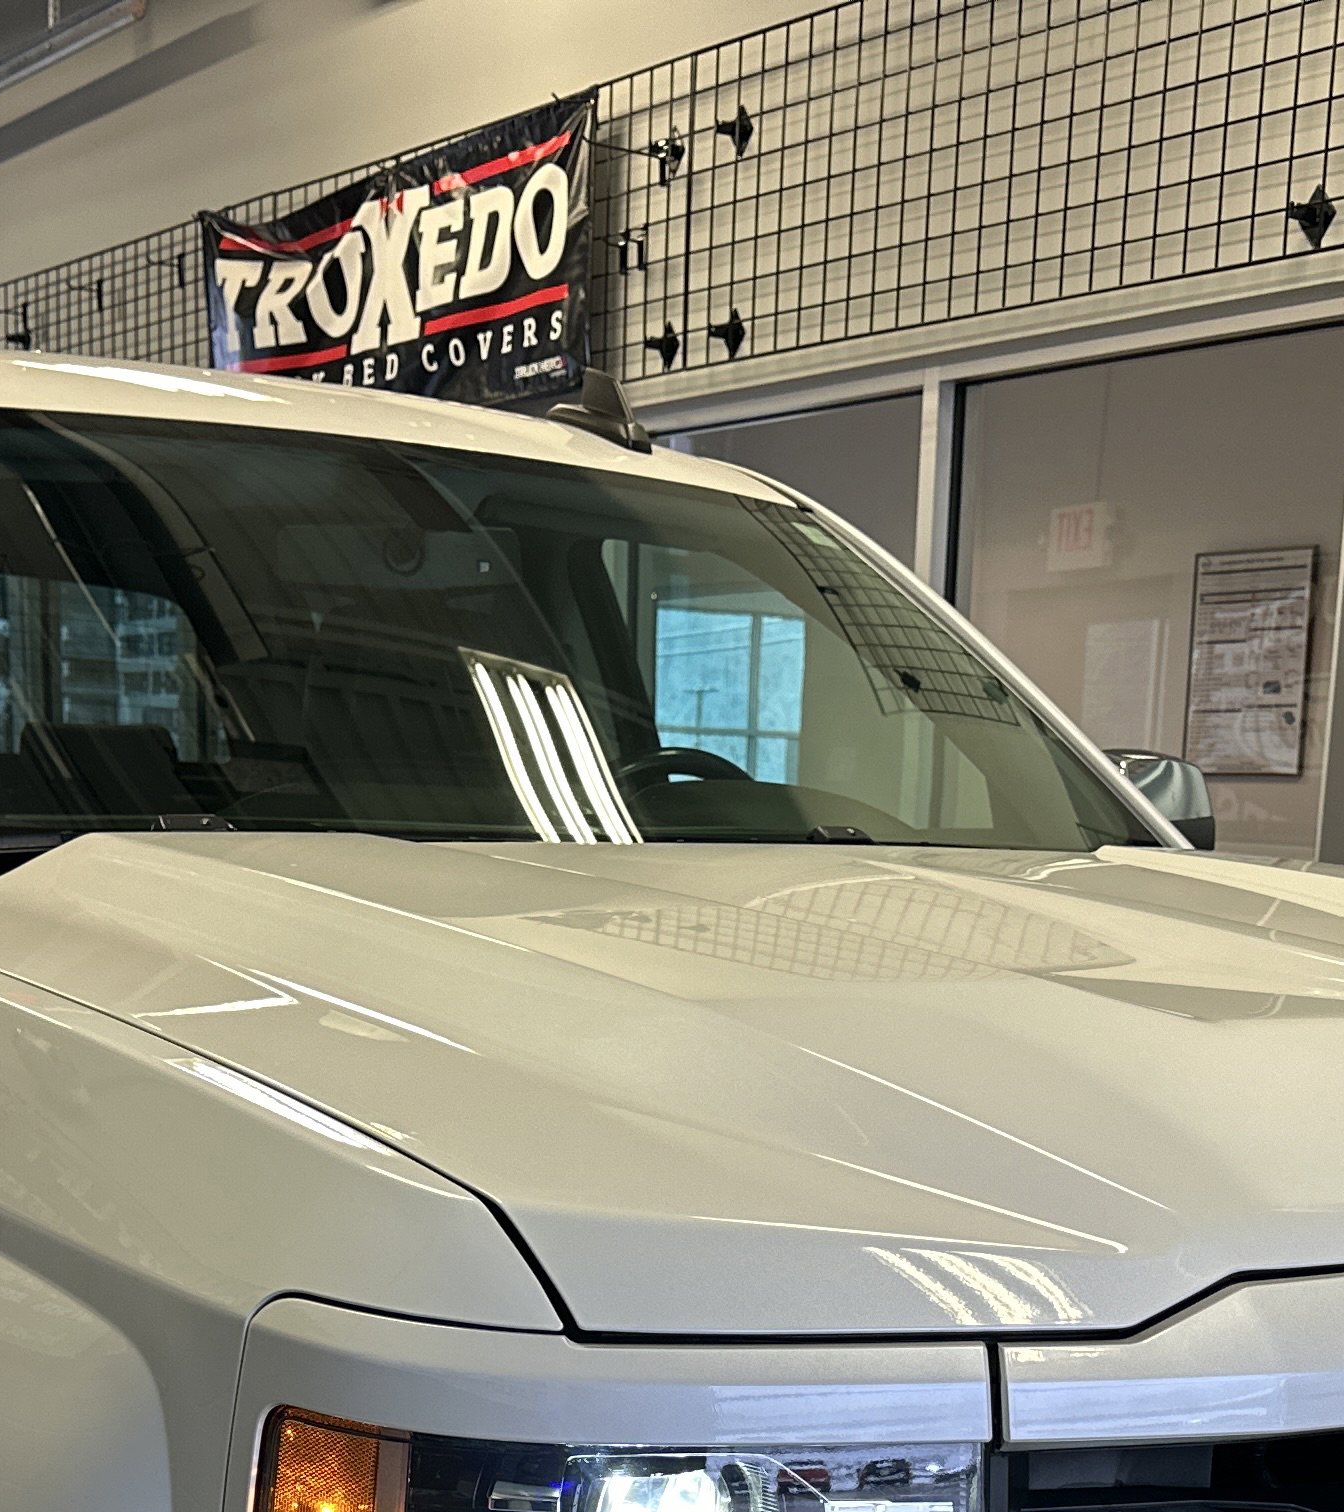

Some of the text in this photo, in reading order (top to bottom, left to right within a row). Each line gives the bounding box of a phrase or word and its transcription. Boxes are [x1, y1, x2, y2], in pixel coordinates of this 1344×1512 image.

[215, 163, 568, 354] TROXEDO
[342, 353, 399, 387] BED
[421, 310, 563, 373] COVERS
